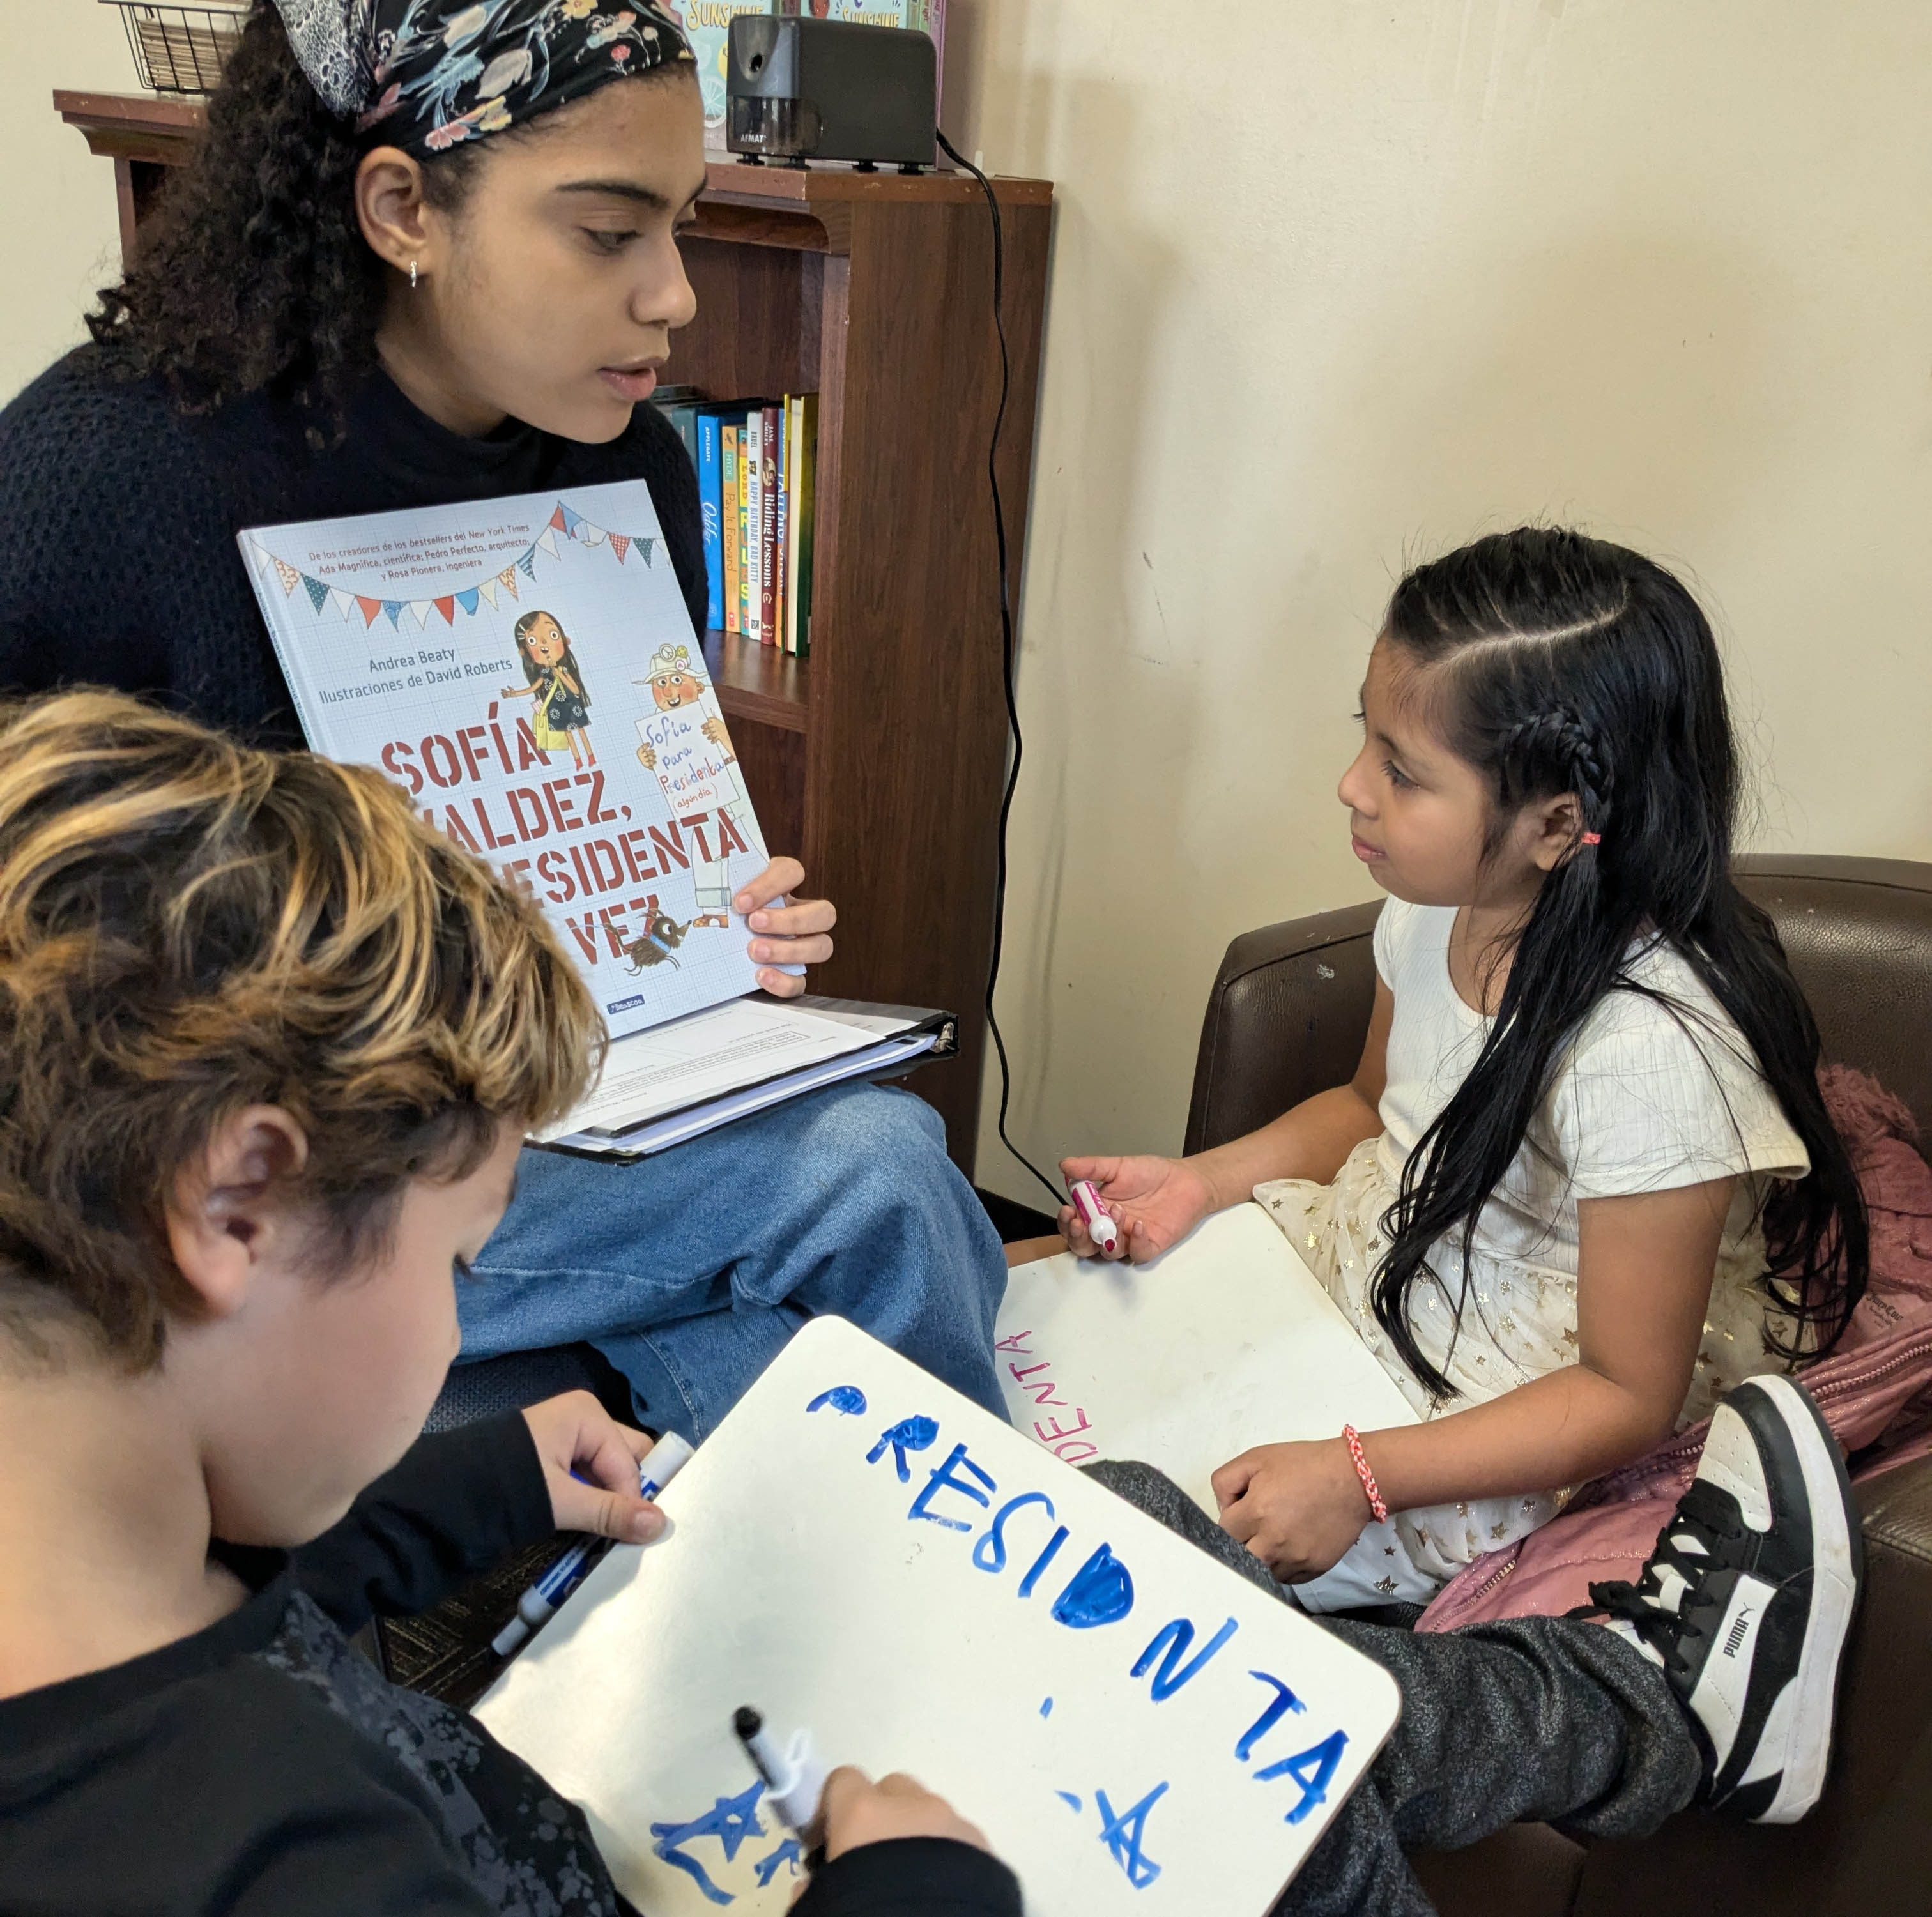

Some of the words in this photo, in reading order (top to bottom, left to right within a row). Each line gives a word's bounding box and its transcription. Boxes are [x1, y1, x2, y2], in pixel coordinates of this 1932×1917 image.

[724, 493, 735, 510] Pay
[749, 481, 758, 505] HAPPY
[702, 501, 717, 546] Odder
[750, 507, 758, 543] BIRTHDAY,
[763, 493, 775, 535] Riding
[309, 552, 321, 561] De
[323, 549, 337, 560] los
[339, 544, 380, 558] creadores
[382, 542, 393, 552] de
[395, 540, 407, 550] los
[410, 534, 452, 548] bestsellers
[454, 532, 466, 542] del
[468, 529, 485, 540] New
[487, 526, 505, 538] York
[507, 523, 530, 533] Times
[319, 564, 336, 575] Ada
[424, 548, 448, 560] Pedro
[450, 544, 487, 556] Perfecto,
[726, 526, 737, 572] Forward
[750, 546, 758, 560] BAD
[381, 573, 387, 582] y
[388, 569, 409, 580] Rosa
[411, 564, 445, 576] Pionera,
[751, 562, 759, 583] KITTY
[763, 536, 774, 588] Lessons
[369, 653, 416, 674] Andrea
[418, 648, 455, 664] Beaty
[319, 679, 404, 704] Ilustraciones
[408, 674, 423, 689] de
[425, 666, 461, 684] David
[464, 658, 514, 678] Roberts
[381, 701, 552, 796] SOFÍA
[662, 747, 693, 770] para
[659, 757, 724, 795] Presidenta
[423, 770, 632, 854] ALDEZ,
[502, 806, 749, 909] ESIDENTA
[806, 1384, 1349, 1825] PRESIDNTA
[1722, 1617, 1750, 1659] PUMA
